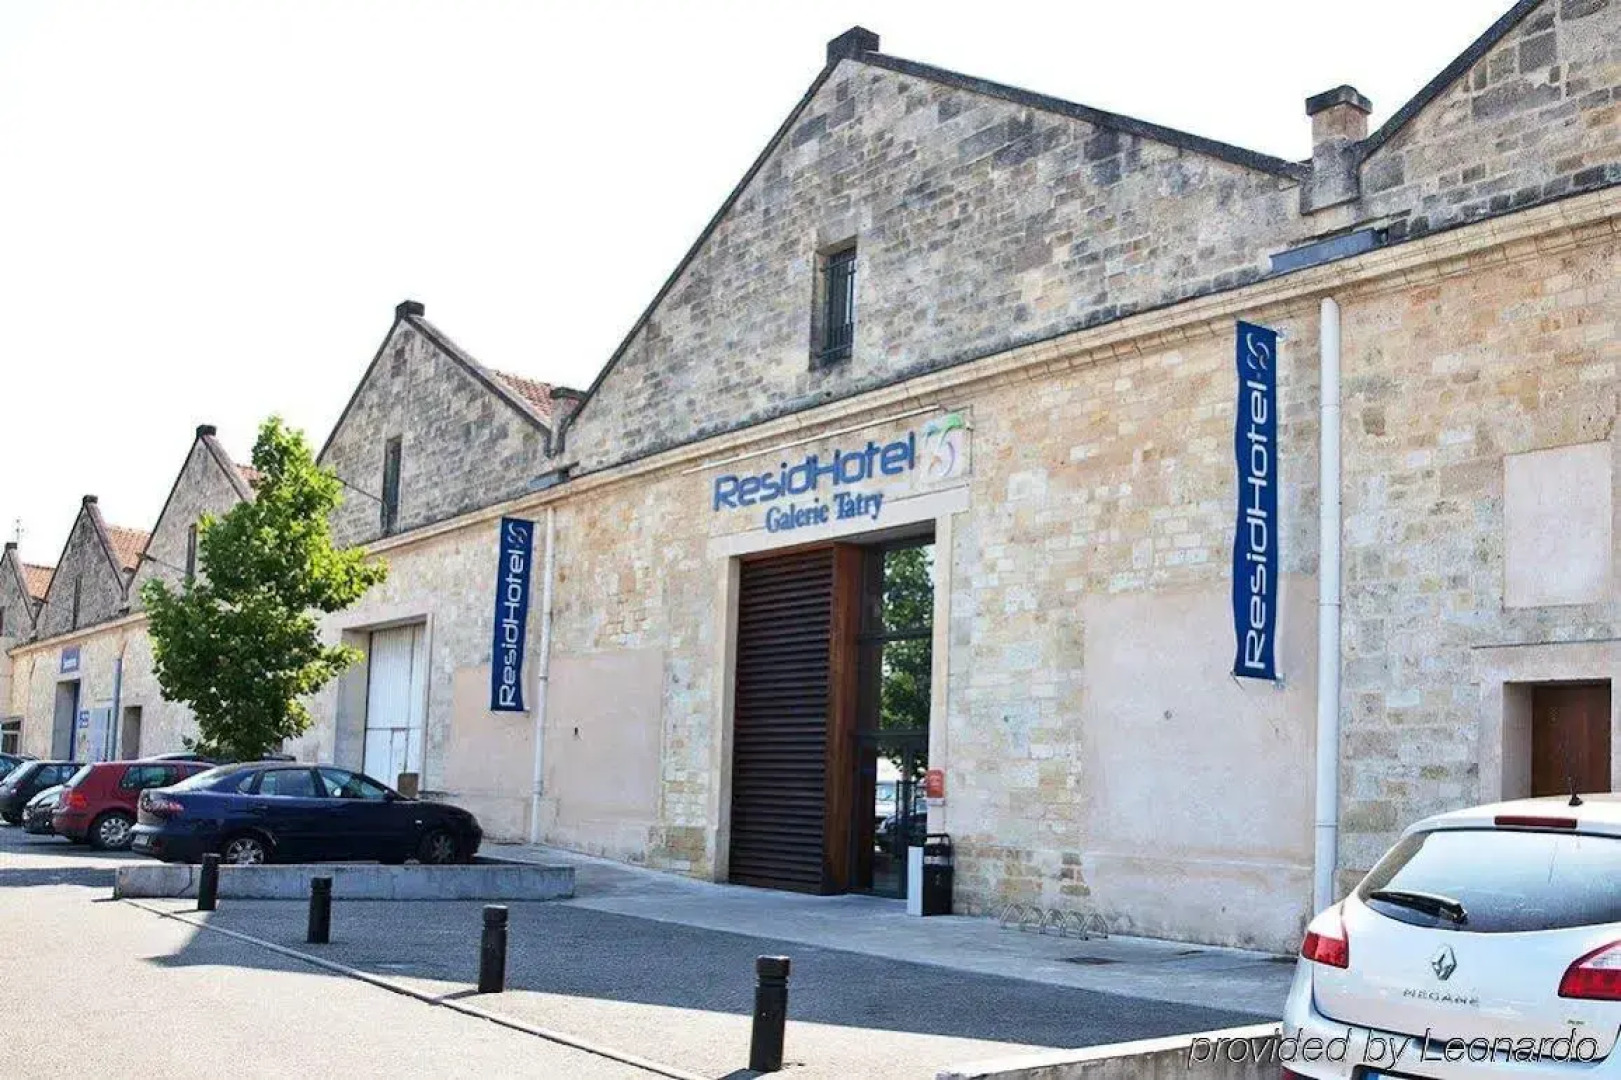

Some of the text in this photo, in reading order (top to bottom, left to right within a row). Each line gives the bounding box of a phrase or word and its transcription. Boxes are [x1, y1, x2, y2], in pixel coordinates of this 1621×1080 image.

[713, 431, 915, 511] ResidHotel
[765, 490, 884, 533] Galerie Tatry
[1244, 380, 1268, 670] ResidHotel
[500, 549, 525, 707] ResidHotel
